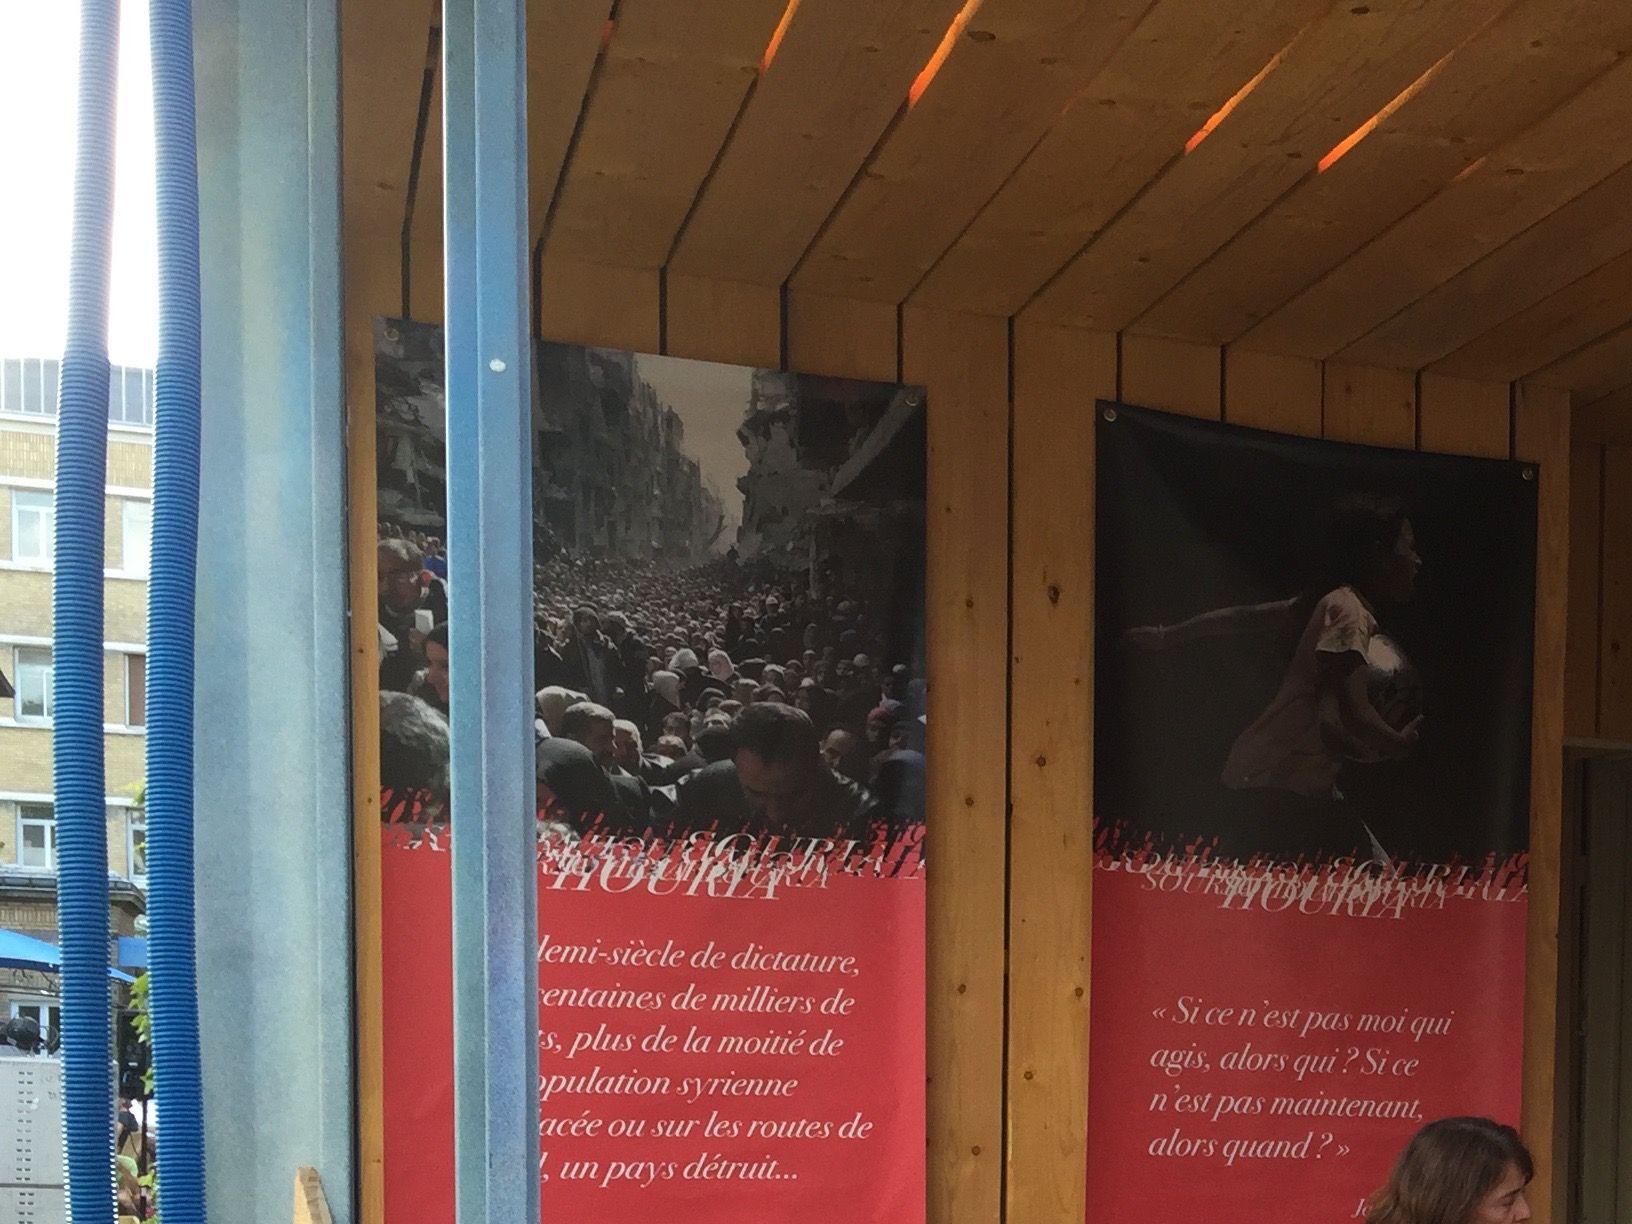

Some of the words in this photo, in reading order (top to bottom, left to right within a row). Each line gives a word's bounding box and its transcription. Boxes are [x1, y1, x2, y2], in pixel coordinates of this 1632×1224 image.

[689, 940, 726, 969] de
[730, 942, 859, 977] dictature,
[670, 982, 707, 1011] de
[711, 985, 816, 1014] milliers
[819, 987, 856, 1015] de
[1174, 996, 1201, 1025] Si
[1204, 1007, 1234, 1026] ce
[1237, 999, 1301, 1029] n'est
[1299, 1011, 1350, 1039] pas
[1356, 1008, 1407, 1033] moi
[1410, 1010, 1455, 1043] qui
[570, 1023, 634, 1059] plus
[641, 1024, 678, 1053] de
[682, 1025, 712, 1053] la
[716, 1029, 805, 1056] moitié
[808, 1028, 844, 1057] de
[1149, 1042, 1211, 1077] agis,
[1219, 1042, 1289, 1071] alors
[1293, 1047, 1338, 1081] qui
[1360, 1048, 1390, 1075] Si
[1391, 1058, 1420, 1077] ce
[538, 1065, 671, 1101] opulation
[676, 1070, 799, 1104] syrienne
[1148, 1083, 1213, 1113] n'est
[1210, 1095, 1266, 1122] pas
[1269, 1090, 1423, 1121] maintenant,
[540, 1109, 603, 1137] acée
[607, 1119, 646, 1137] ou
[651, 1119, 701, 1138] sur
[703, 1110, 740, 1138] les
[746, 1118, 834, 1139] routes
[837, 1111, 873, 1139] de
[1148, 1127, 1219, 1157] alors
[1222, 1131, 1314, 1167] quand
[559, 1161, 599, 1180] un
[601, 1161, 677, 1189] pays
[682, 1151, 798, 1180] détruit...
